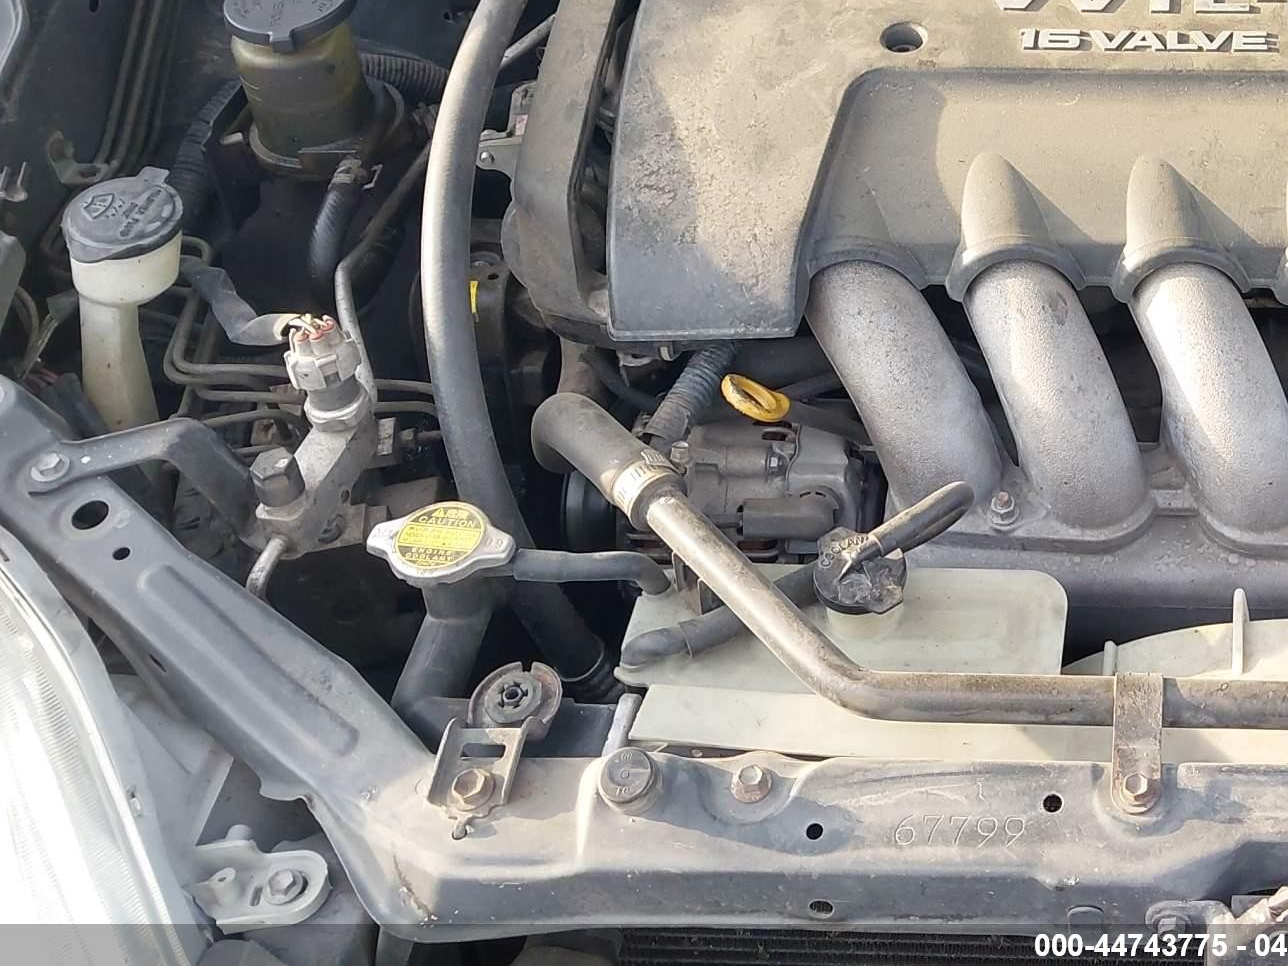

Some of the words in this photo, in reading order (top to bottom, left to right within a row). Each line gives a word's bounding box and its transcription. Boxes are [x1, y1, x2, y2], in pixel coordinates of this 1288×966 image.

[1019, 27, 1088, 52] 16
[1088, 30, 1279, 53] VALVE
[418, 515, 475, 528] CAUTION
[894, 811, 1026, 848] 67799
